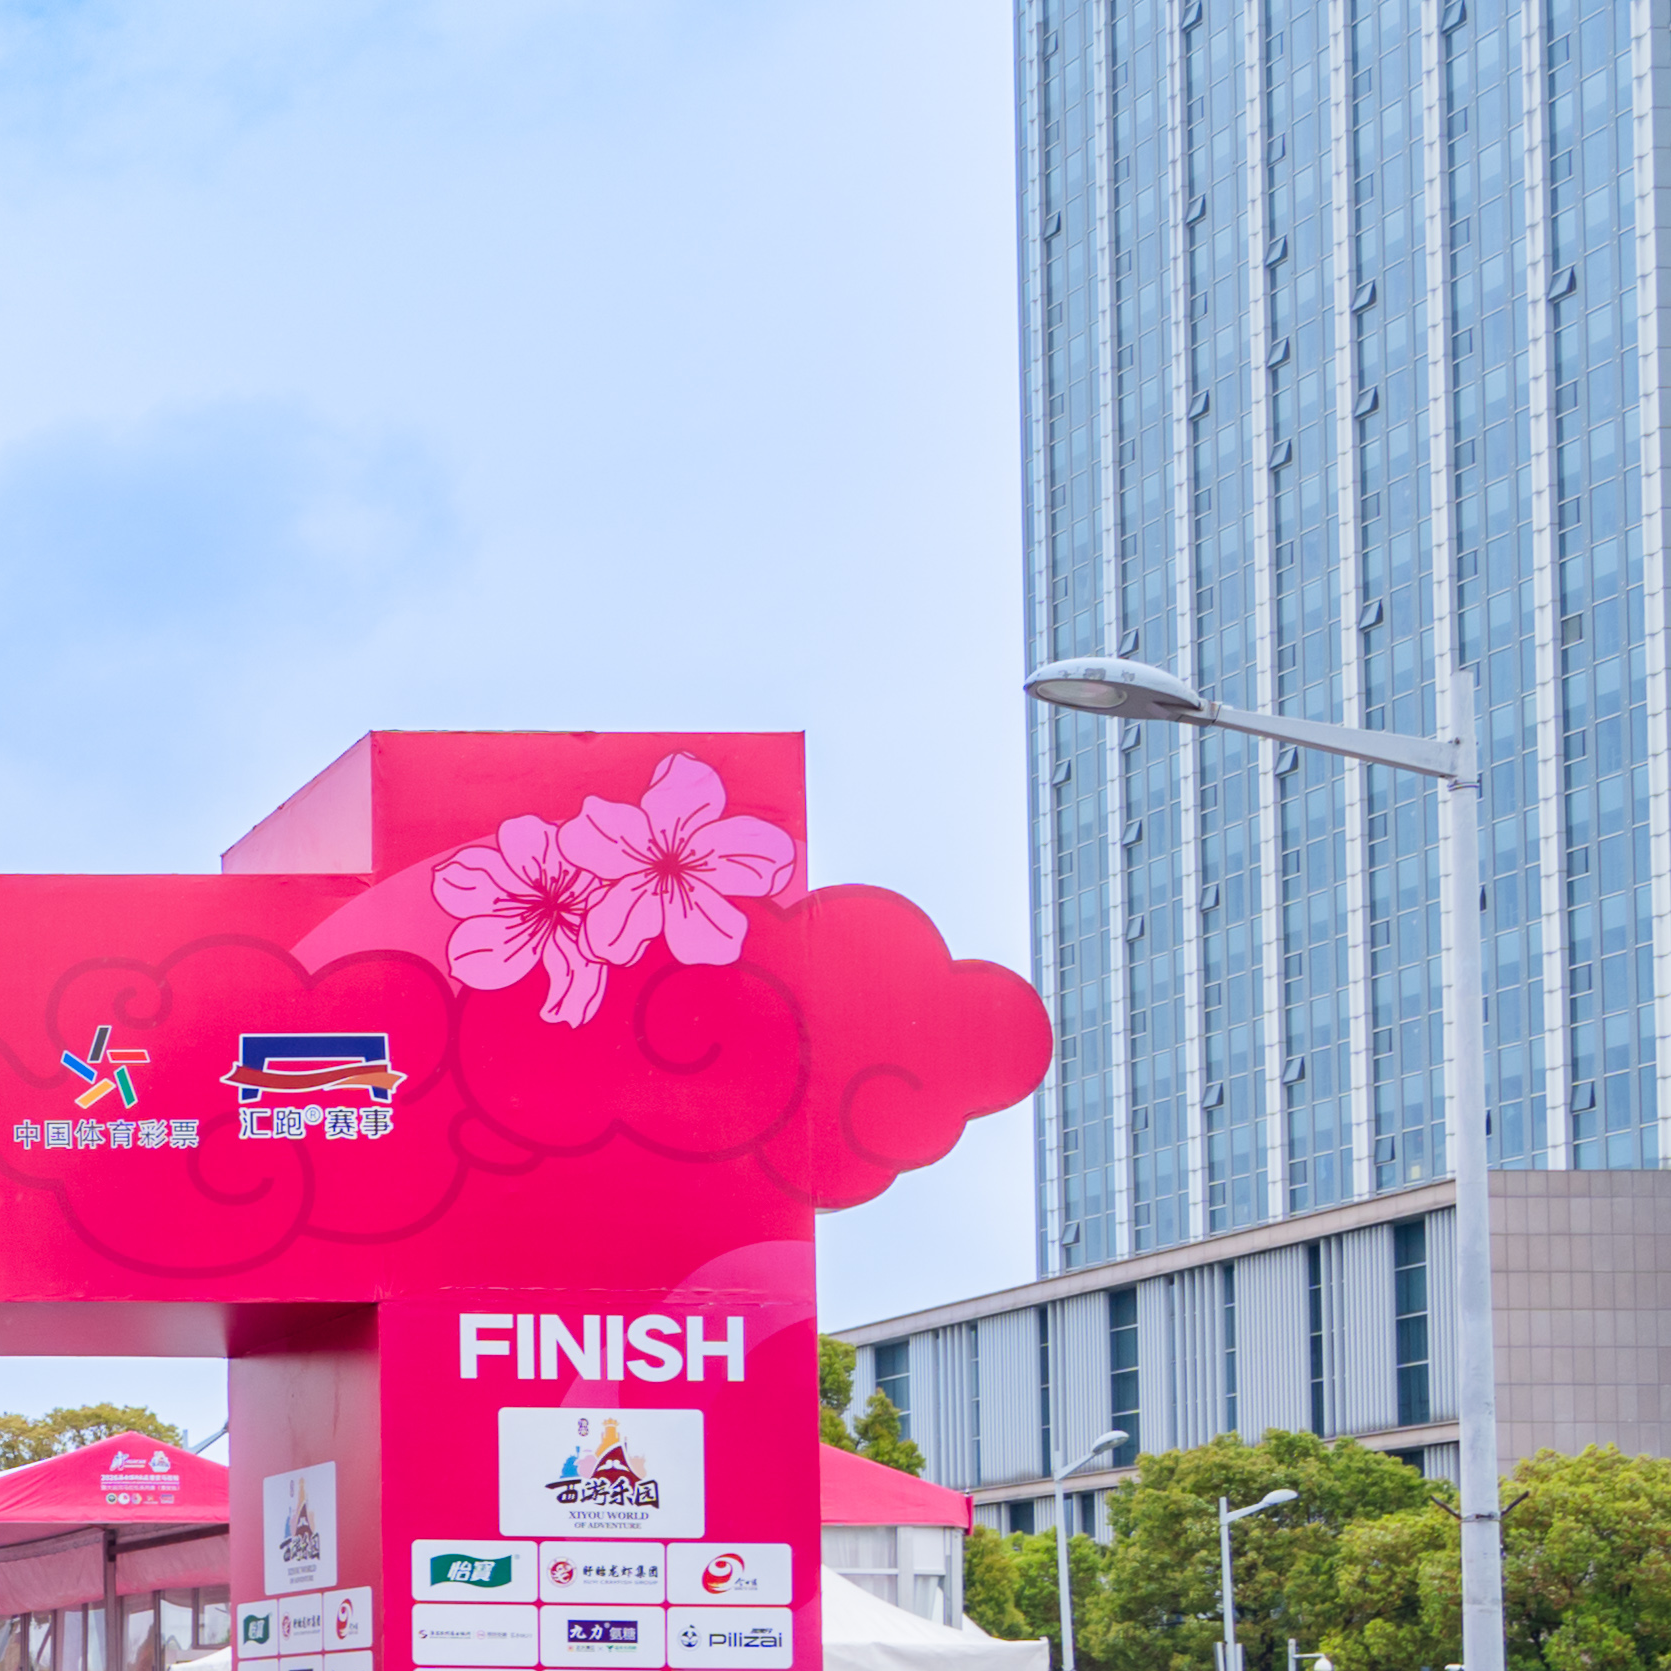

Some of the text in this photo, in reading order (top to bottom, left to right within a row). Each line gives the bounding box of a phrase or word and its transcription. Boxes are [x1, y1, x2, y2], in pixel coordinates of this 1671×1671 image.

[14, 1119, 199, 1149] 中国体育彩票
[459, 1313, 746, 1383] FINISH
[545, 1478, 660, 1509] 西游乐园
[568, 1511, 649, 1521] XIYOU WORLD
[588, 1522, 642, 1530] ADVENTURE
[709, 1632, 783, 1647] Pilizai
